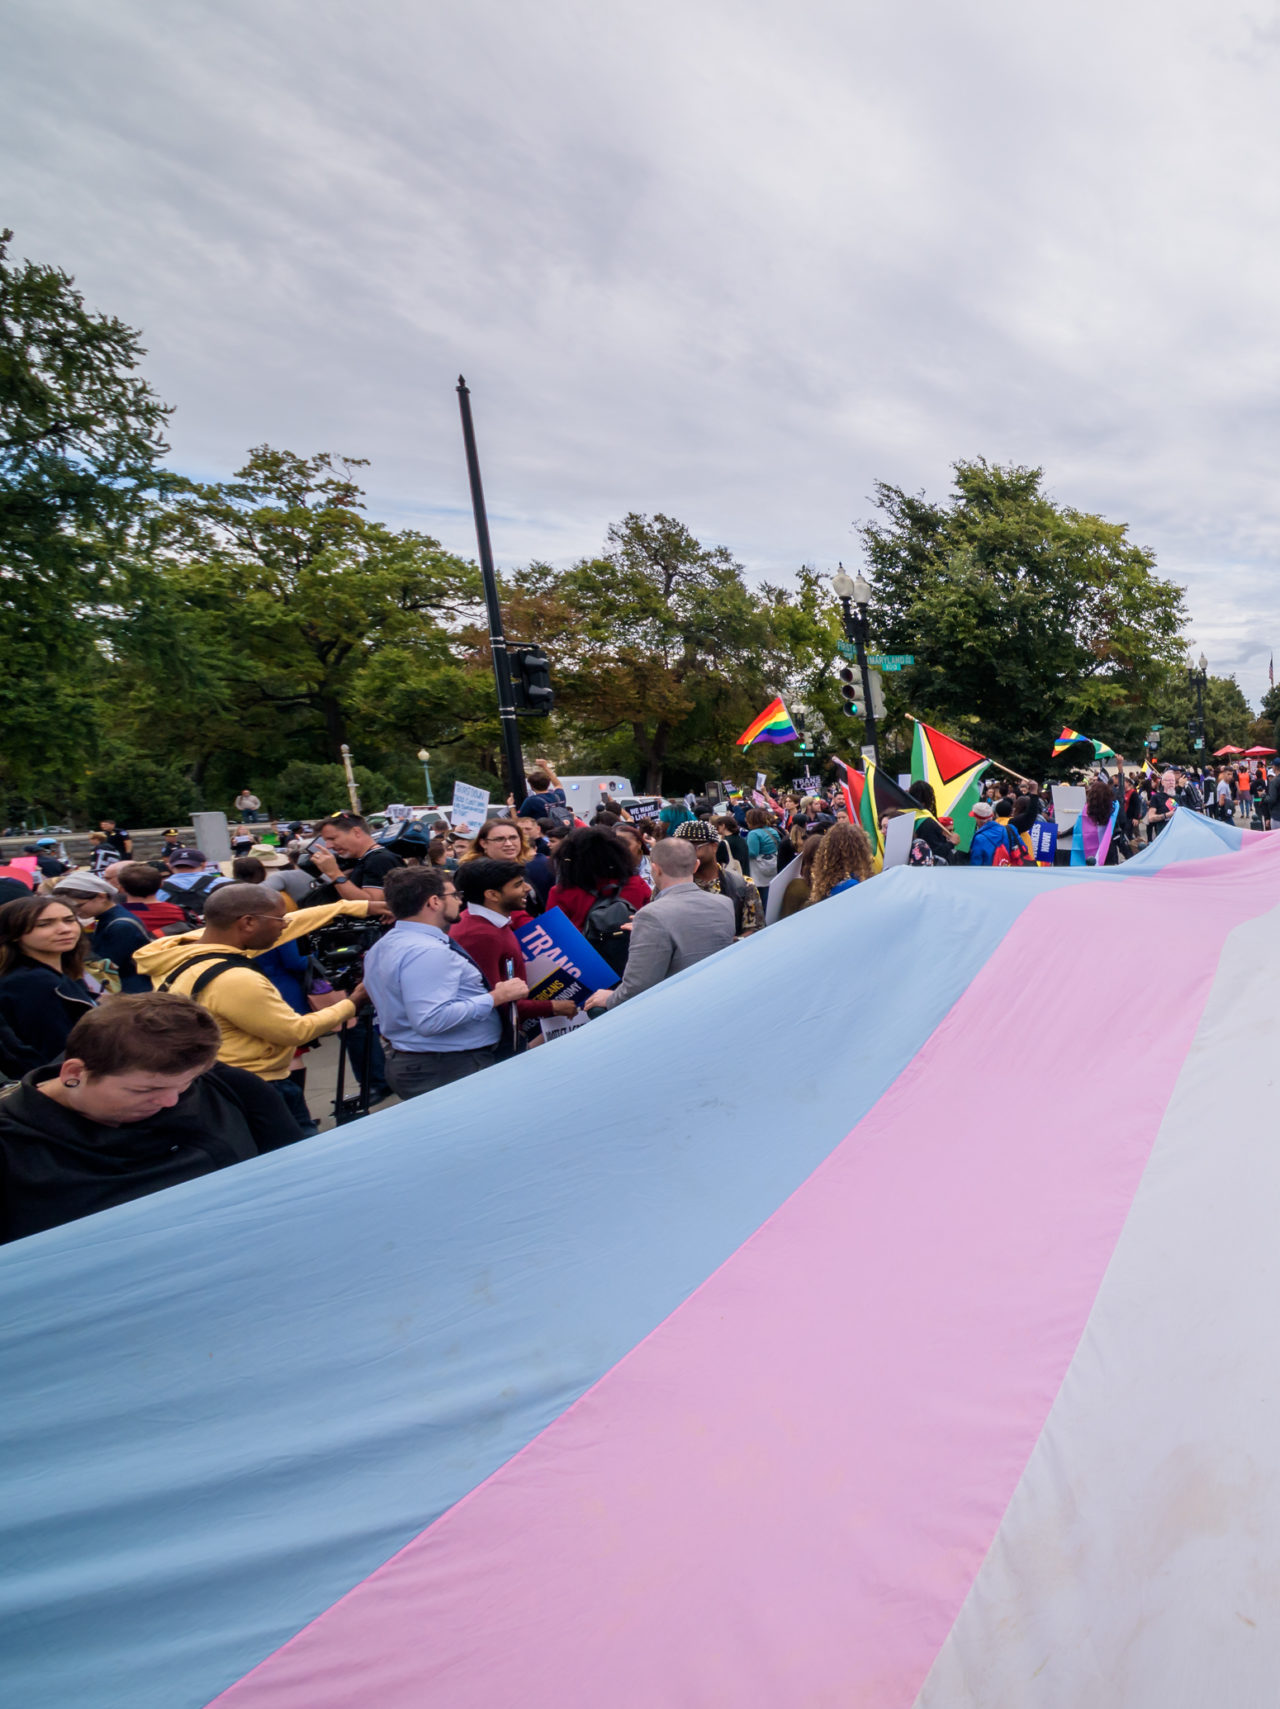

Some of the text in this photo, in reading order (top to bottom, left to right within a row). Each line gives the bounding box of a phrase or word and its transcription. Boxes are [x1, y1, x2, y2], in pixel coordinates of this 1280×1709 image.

[869, 656, 904, 664] MARYLAND
[640, 804, 655, 812] WANT
[554, 981, 582, 1000] ONOMY
